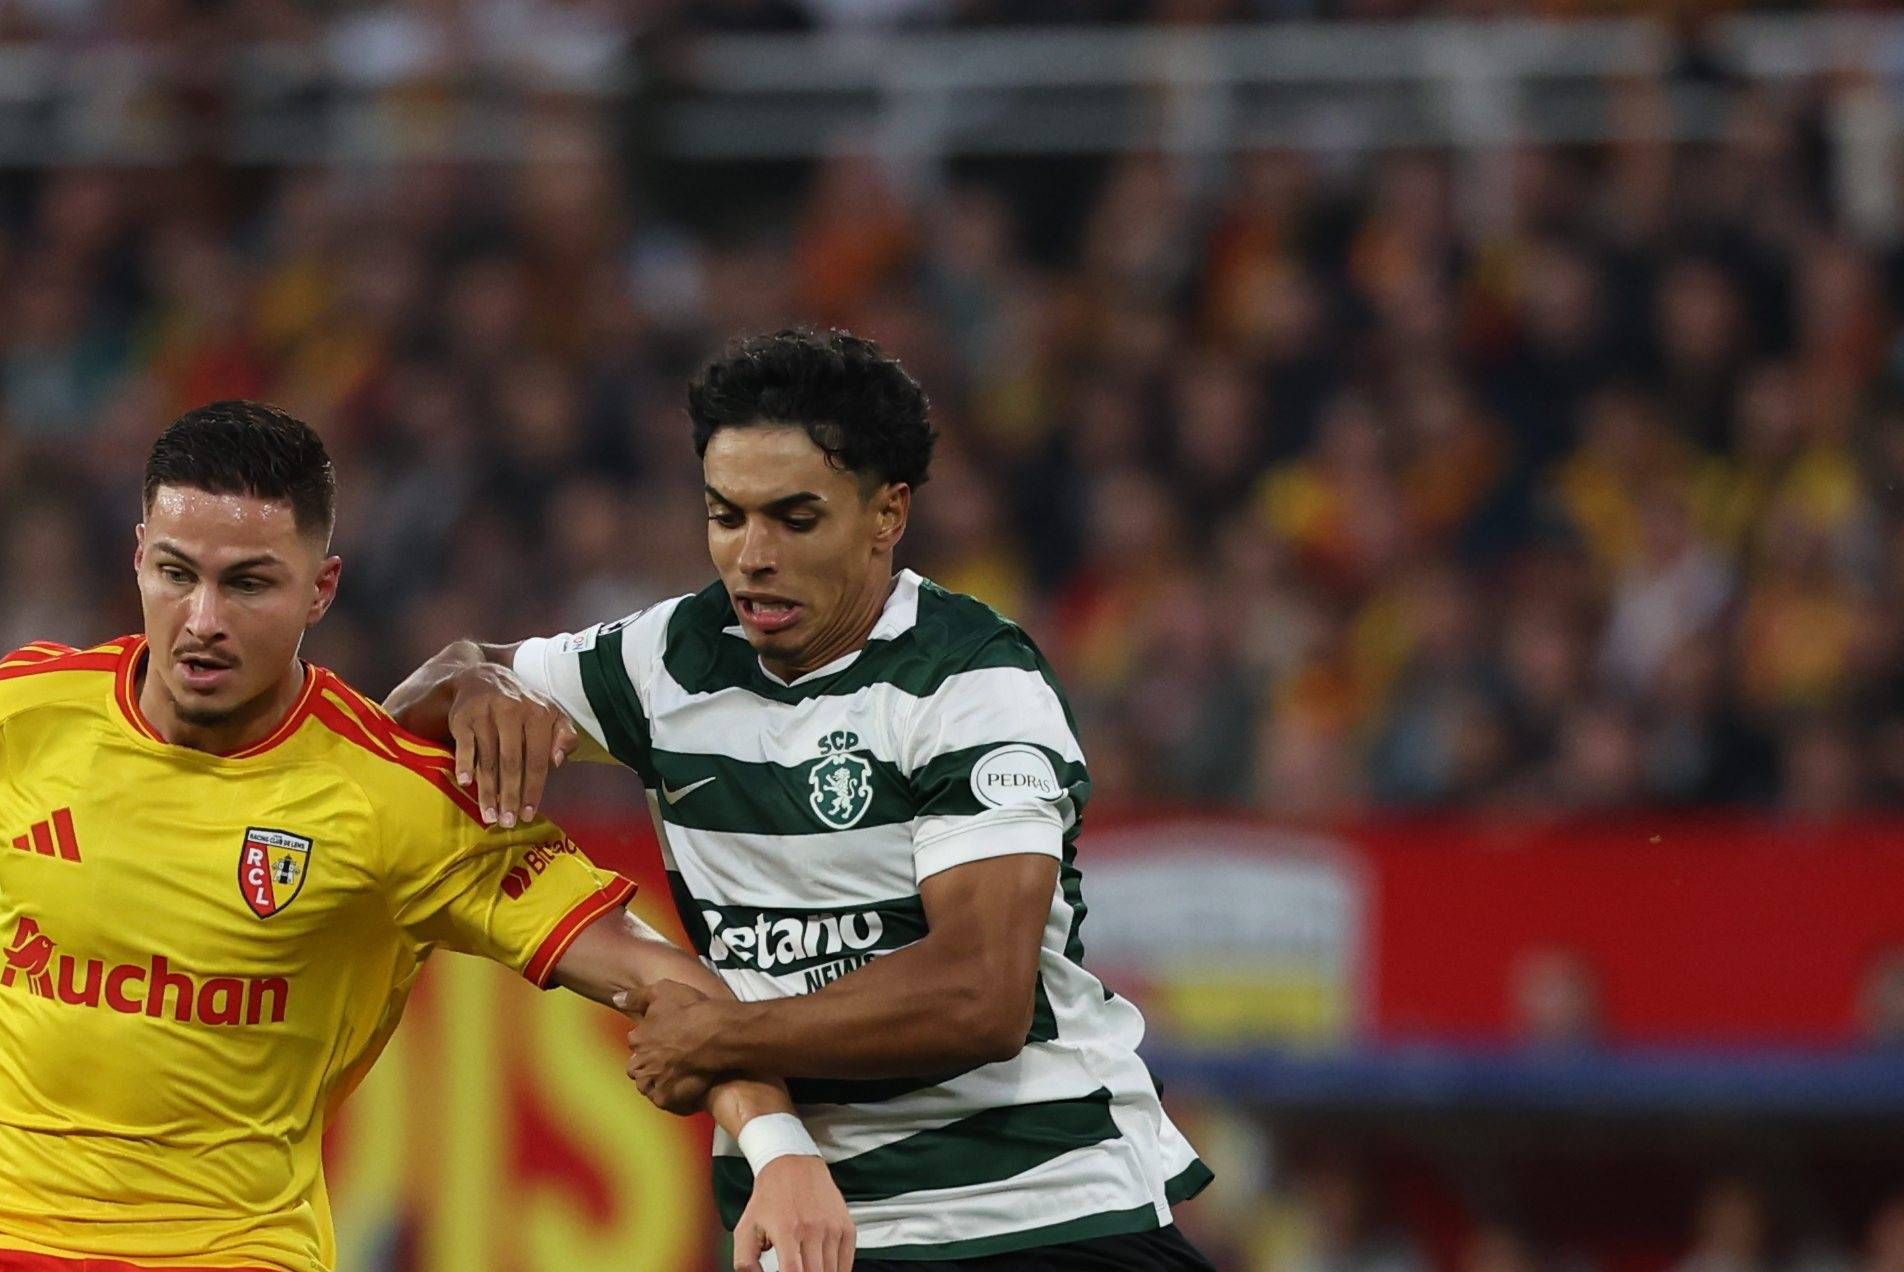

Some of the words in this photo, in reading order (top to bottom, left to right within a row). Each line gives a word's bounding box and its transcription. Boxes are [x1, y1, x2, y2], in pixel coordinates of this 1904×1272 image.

[987, 773, 1050, 793] PEDRAS
[246, 847, 269, 906] RCL
[0, 916, 288, 1026] Auchan
